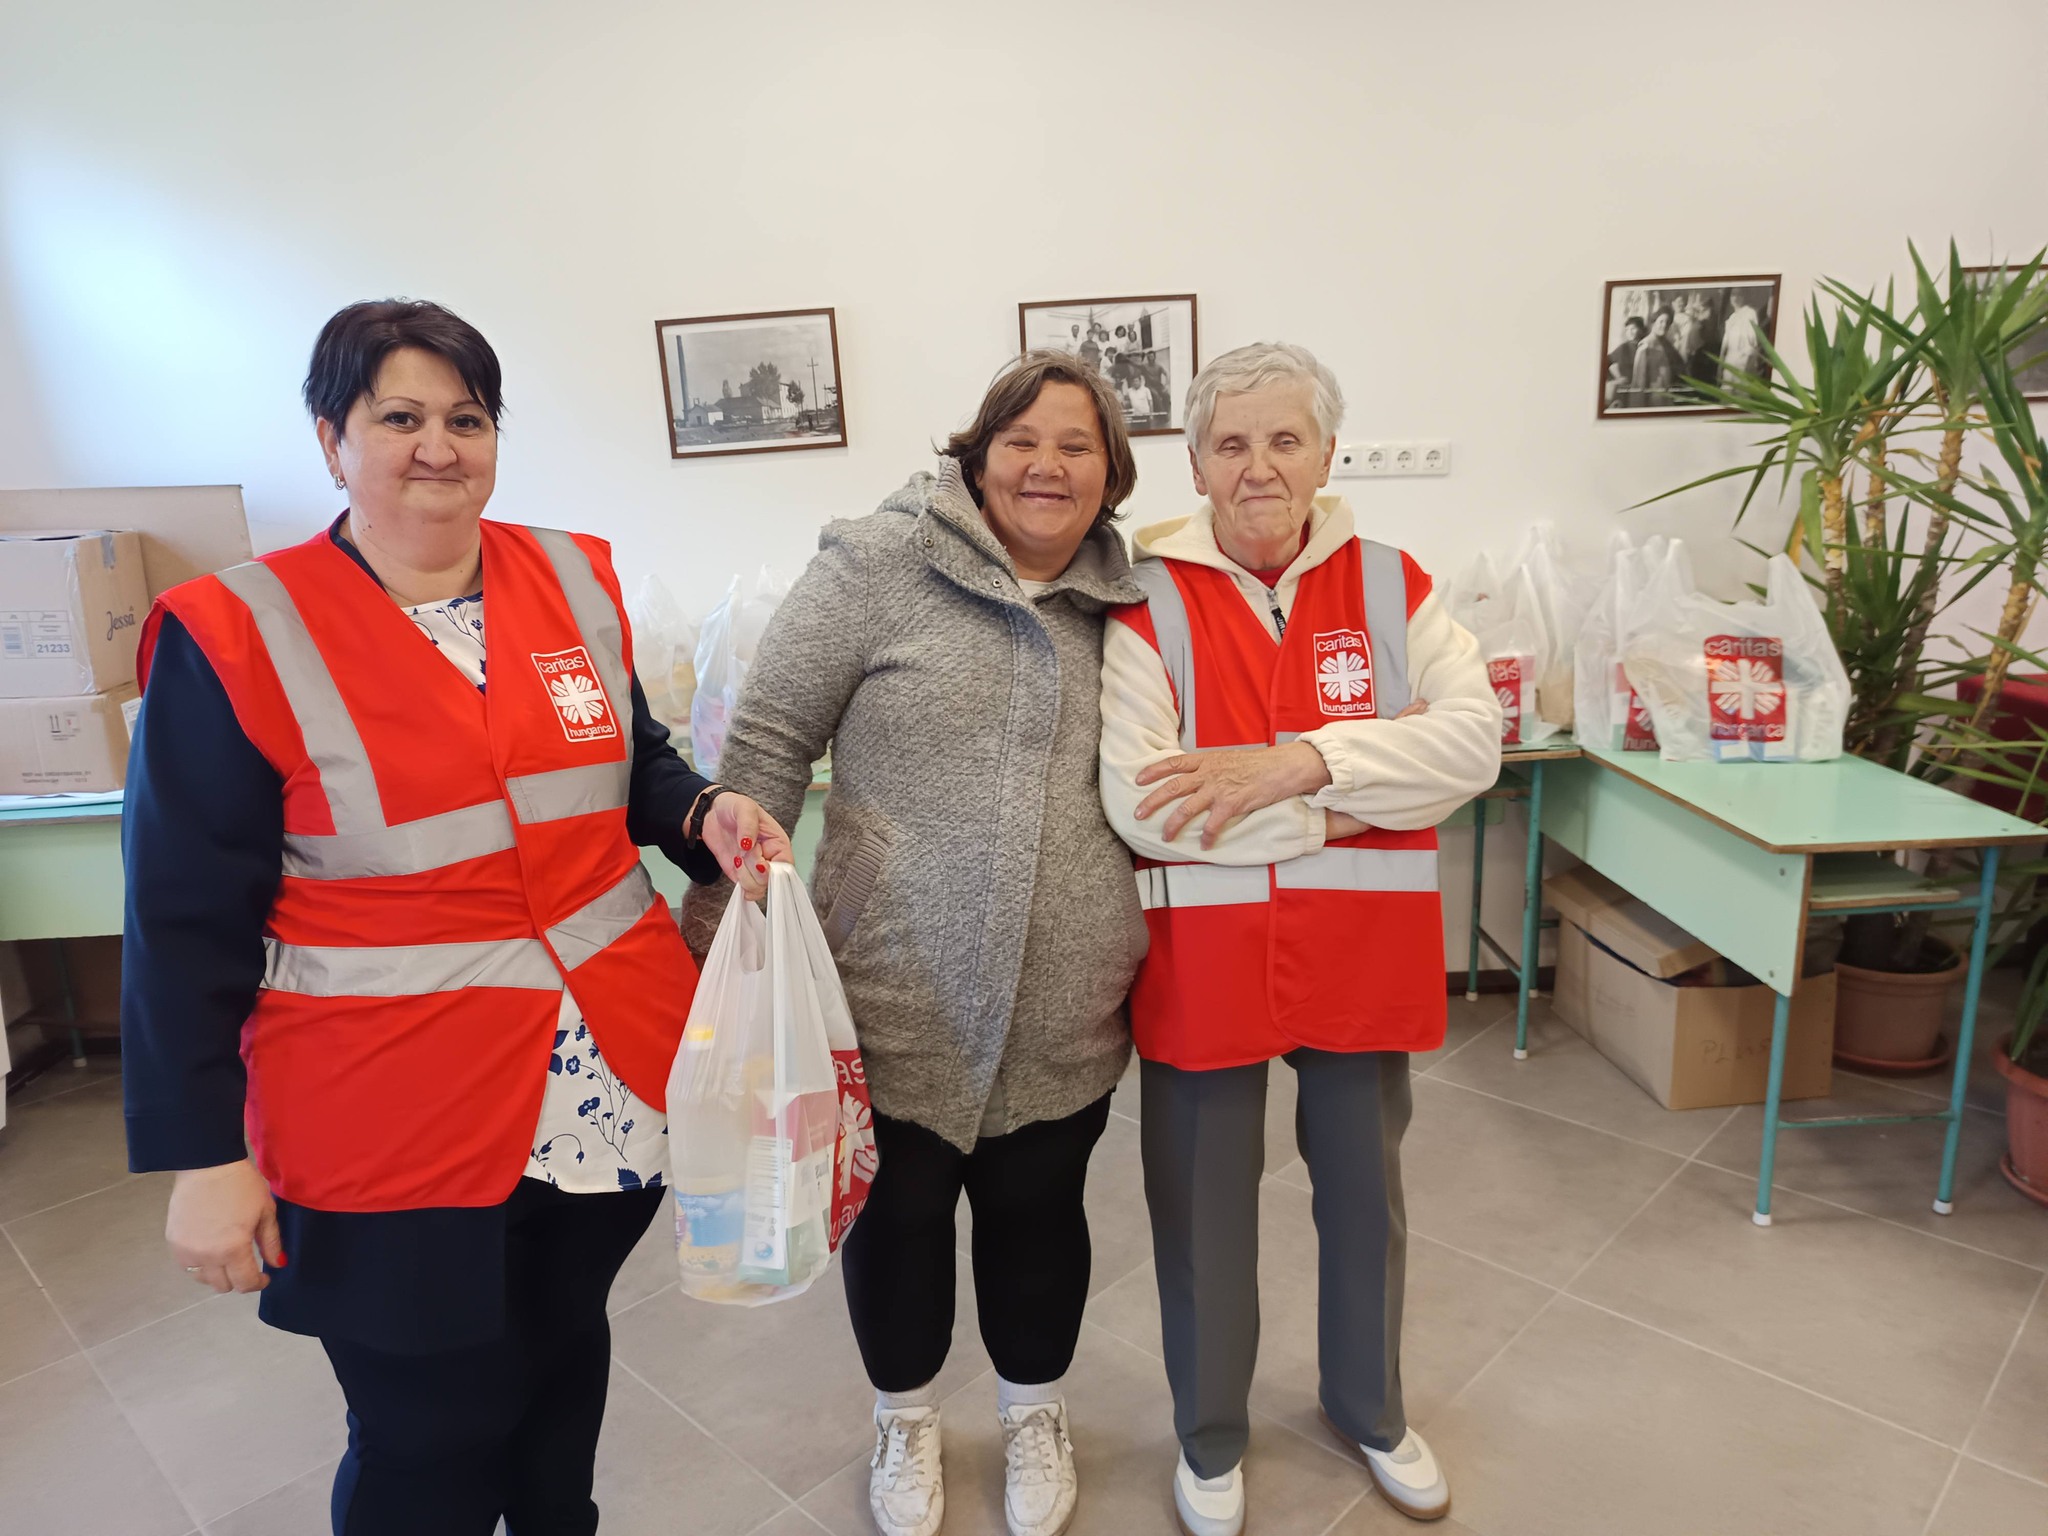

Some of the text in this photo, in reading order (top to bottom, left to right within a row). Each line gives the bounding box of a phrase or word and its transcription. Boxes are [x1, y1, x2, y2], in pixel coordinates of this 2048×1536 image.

[36, 643, 71, 654] 21233
[1317, 635, 1362, 652] caritas
[1703, 639, 1782, 657] caritas
[539, 656, 585, 673] caritas
[1323, 702, 1371, 713] hungarica
[568, 724, 613, 737] hungarica
